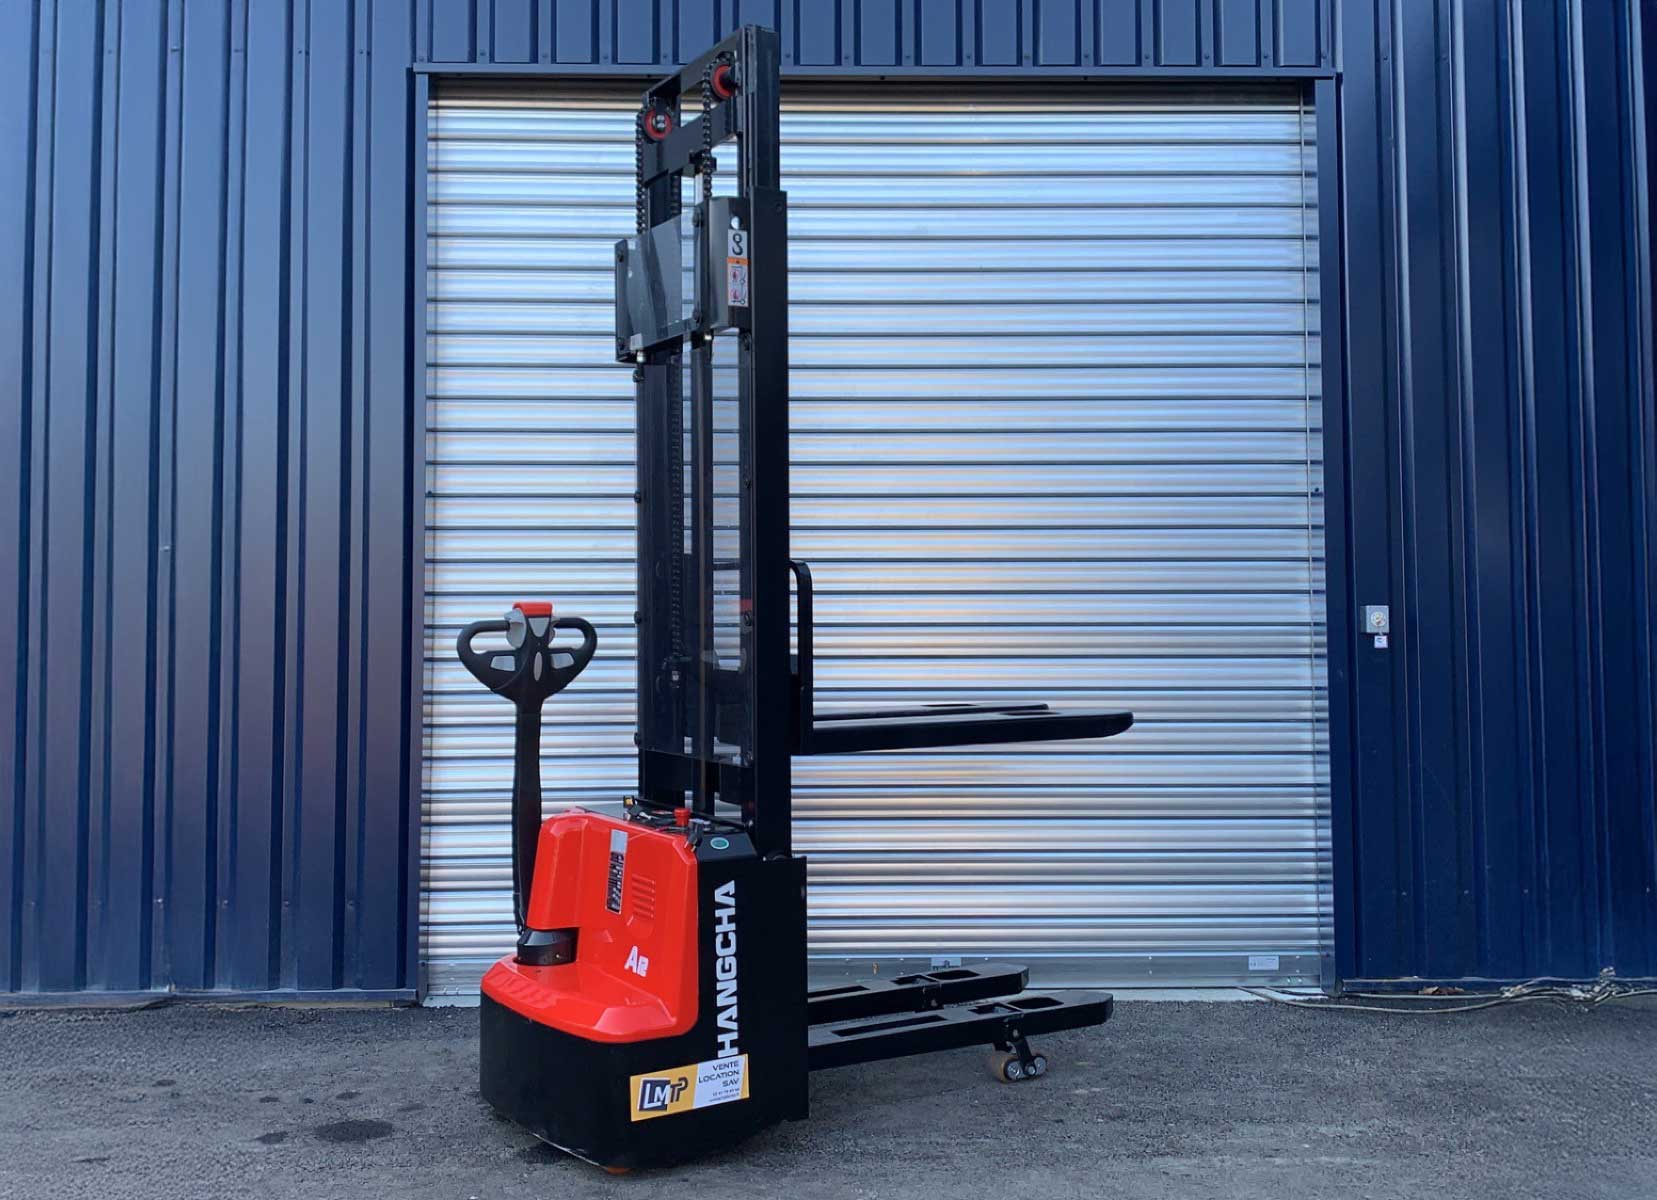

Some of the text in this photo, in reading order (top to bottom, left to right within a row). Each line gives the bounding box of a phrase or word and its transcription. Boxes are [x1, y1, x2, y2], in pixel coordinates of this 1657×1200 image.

[714, 880, 739, 1058] HANGCHA
[712, 1060, 739, 1071] VENTE
[698, 1069, 740, 1084] LOCATION
[722, 1078, 740, 1088] SAV
